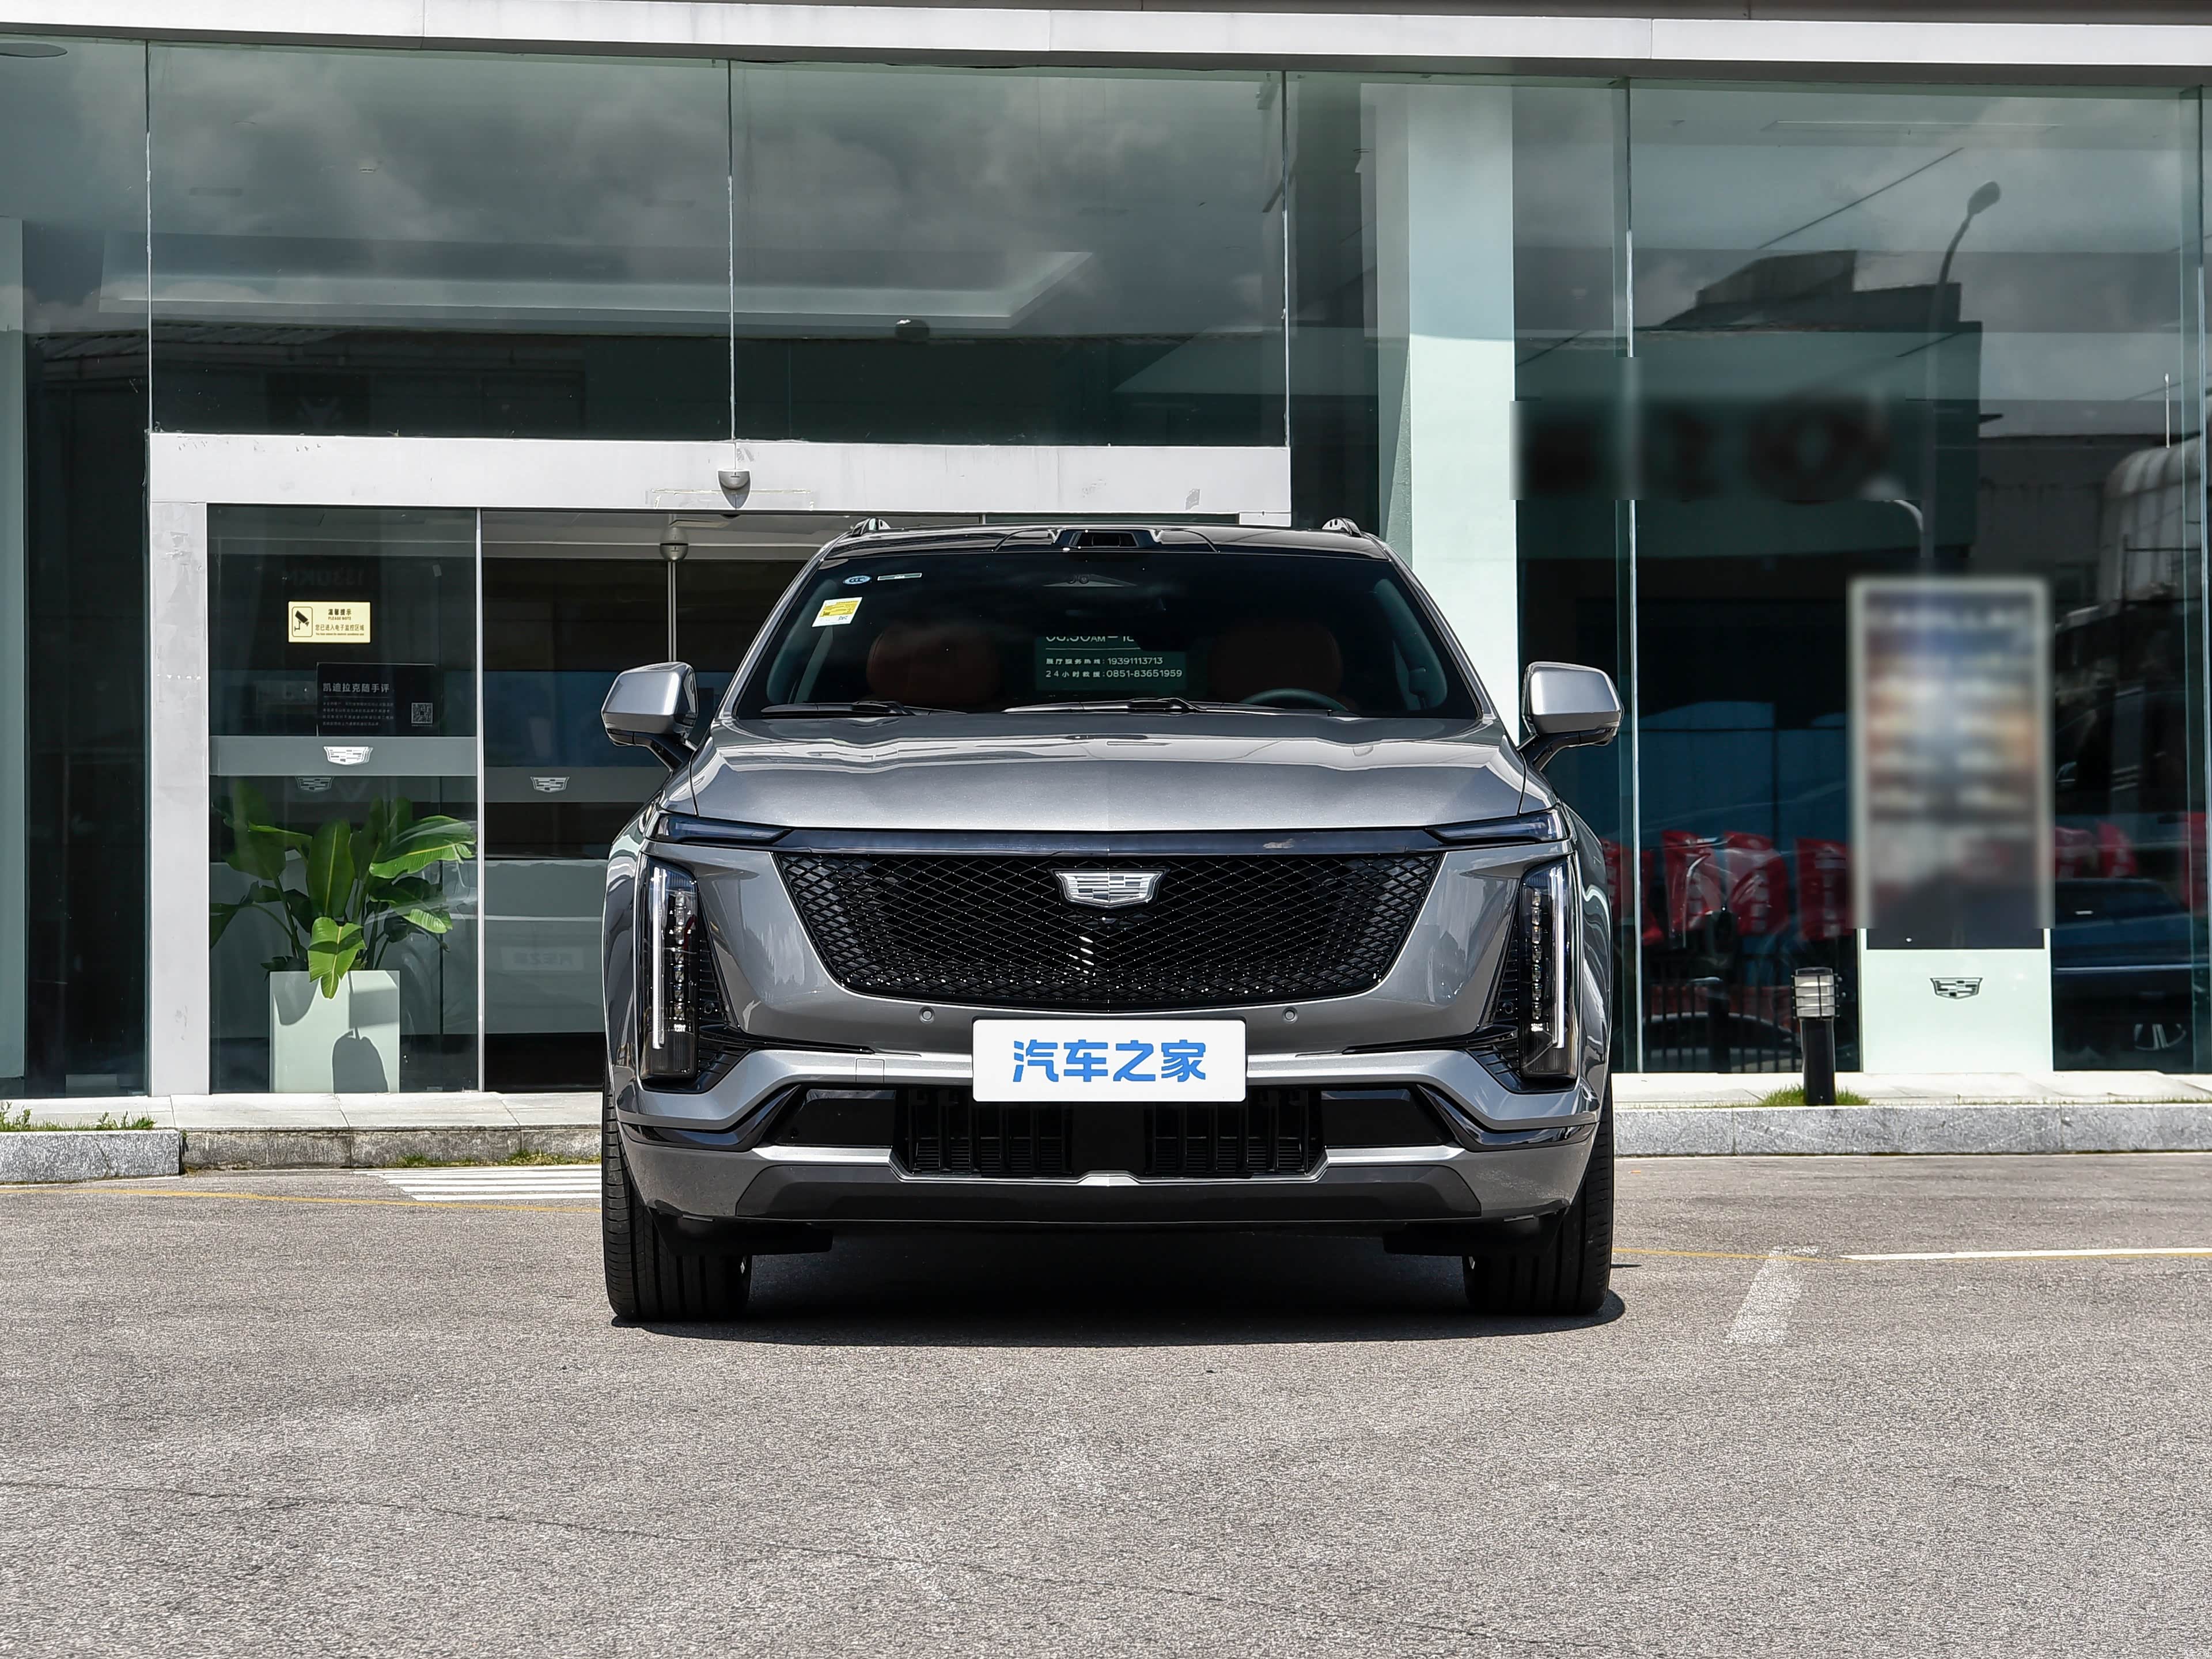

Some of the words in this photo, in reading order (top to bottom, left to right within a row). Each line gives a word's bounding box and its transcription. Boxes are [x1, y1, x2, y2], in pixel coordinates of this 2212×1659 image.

[323, 682, 390, 693] 凯迪拉克随手评
[1013, 1039, 1206, 1082] 汽车之家
